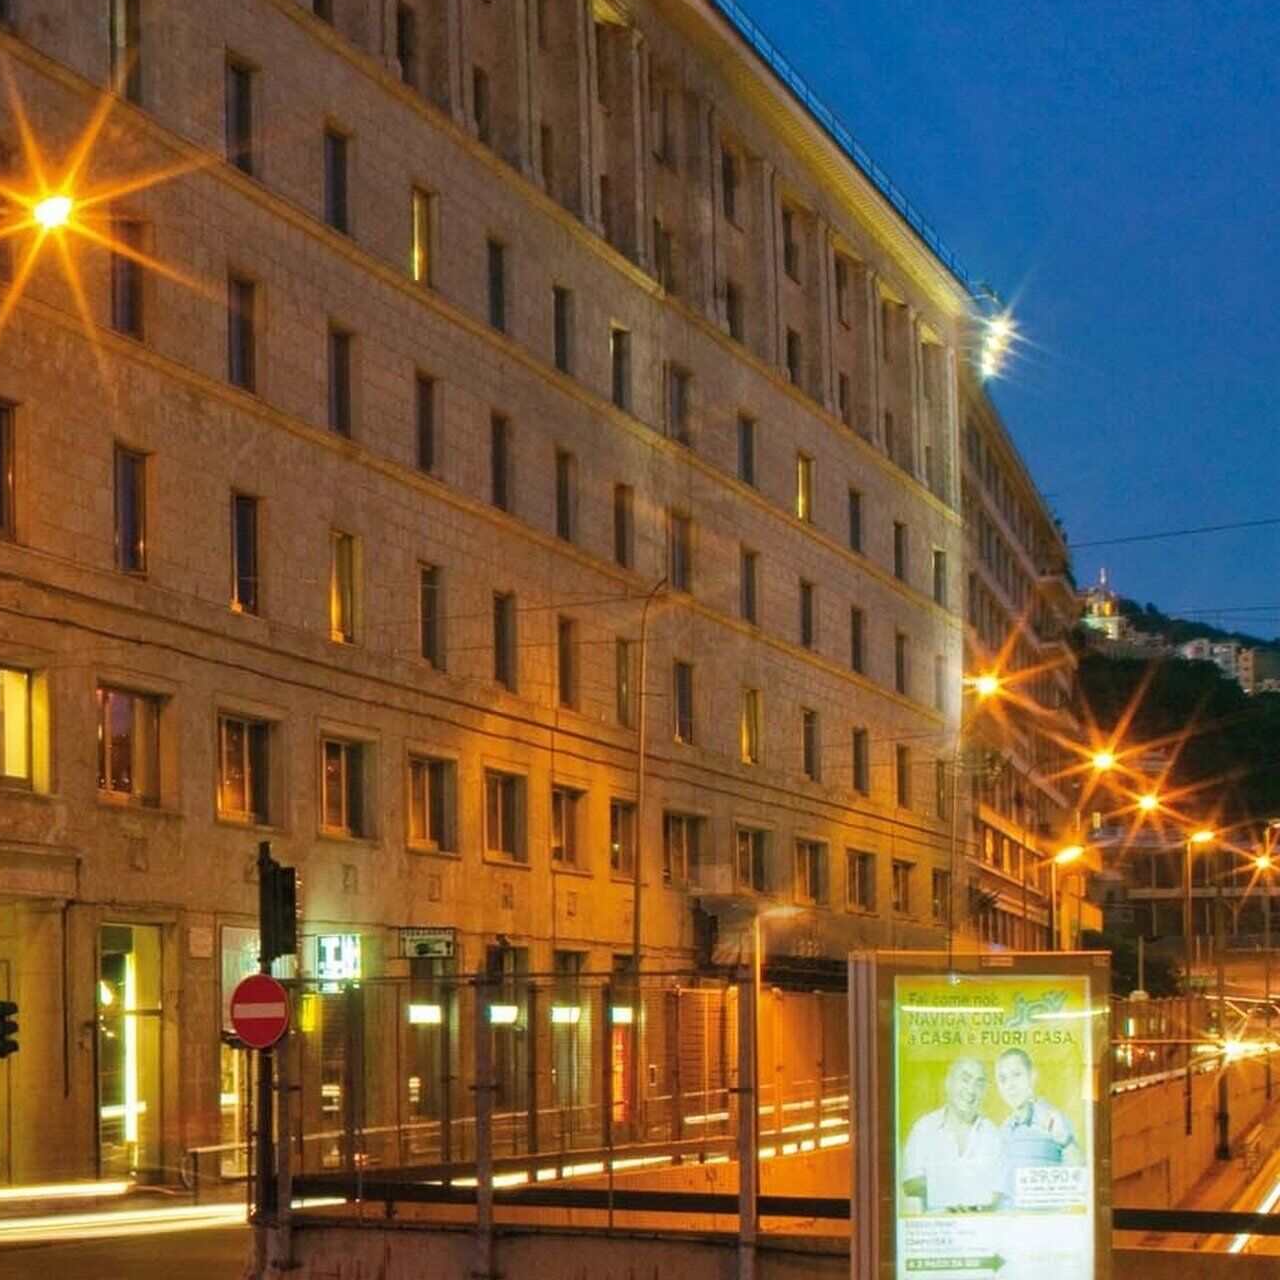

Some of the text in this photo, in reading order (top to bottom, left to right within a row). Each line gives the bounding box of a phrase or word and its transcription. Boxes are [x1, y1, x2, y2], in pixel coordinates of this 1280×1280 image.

[908, 1012, 1004, 1026] NAVIGA CON
[920, 1031, 962, 1045] CASA
[980, 1031, 1027, 1045] FUORI
